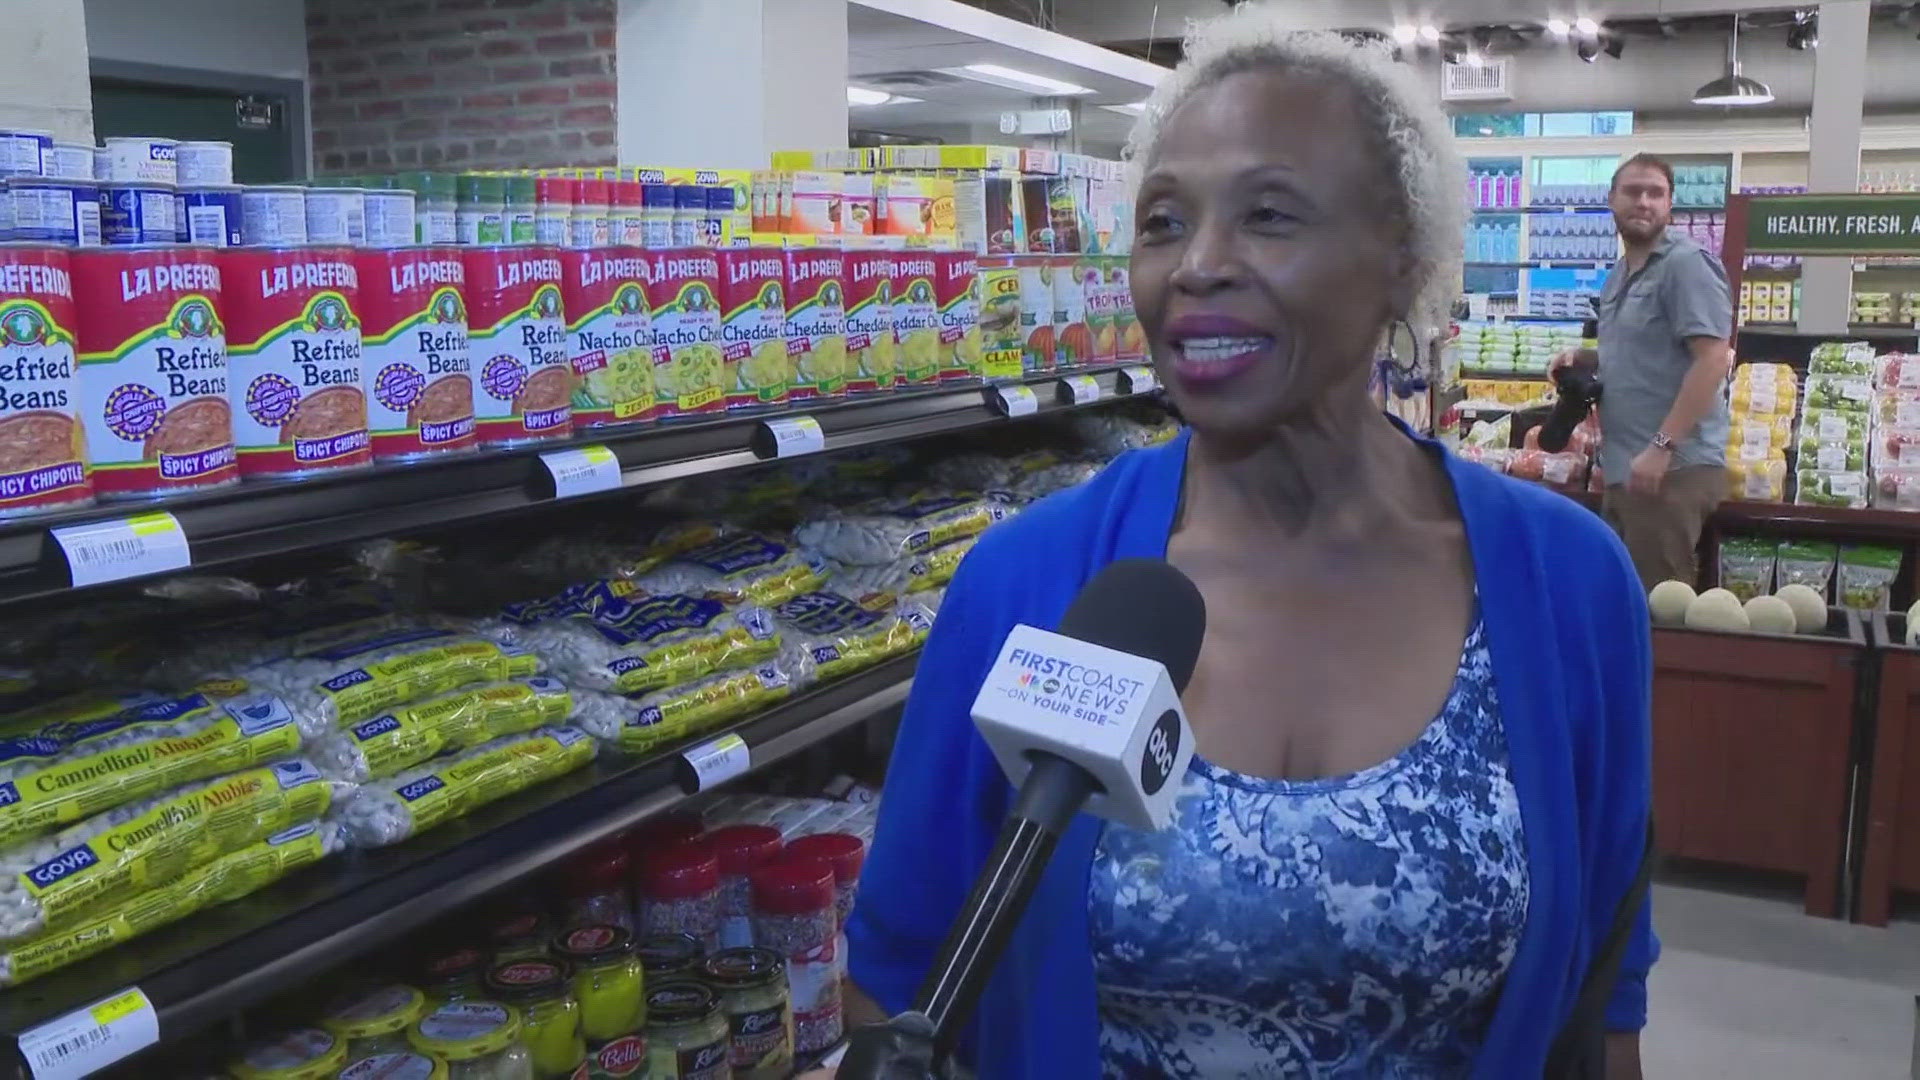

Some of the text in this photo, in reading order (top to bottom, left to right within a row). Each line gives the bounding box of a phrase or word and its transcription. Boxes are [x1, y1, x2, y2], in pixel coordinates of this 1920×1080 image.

[1767, 215, 1840, 235] HEALTHY,
[1845, 215, 1905, 235] FRESH,
[391, 263, 415, 294] LA
[497, 261, 521, 290] LA
[581, 261, 602, 288] LA
[647, 261, 666, 287] LA
[731, 261, 749, 285] LA
[791, 261, 809, 283] LA
[853, 261, 869, 283] LA
[948, 261, 963, 281] LA
[121, 267, 151, 302] LA
[261, 266, 288, 299] LA
[723, 323, 777, 341] Cheddar
[785, 320, 837, 337] Cheddar
[292, 339, 360, 363] Refried
[579, 331, 631, 351] Nacho
[573, 351, 604, 367] GLUTEN
[580, 359, 600, 373] FREE
[168, 373, 226, 397] Beans
[302, 364, 360, 387] Beans
[624, 396, 651, 415] ZESTY
[688, 391, 717, 407] ZESTY
[526, 412, 552, 429] SPICY
[423, 426, 451, 441] SPICY
[297, 443, 331, 459] SPICY
[164, 456, 200, 475] SPICY
[30, 468, 83, 490] CHIPOTLE
[328, 671, 368, 689] GOYA
[1007, 689, 1108, 727] ON YOUR SIDE
[1061, 685, 1129, 715] NEWS
[356, 717, 397, 738] GOYA
[1149, 727, 1173, 778] abc
[403, 777, 442, 798] GOYA
[35, 849, 93, 882] GOYA
